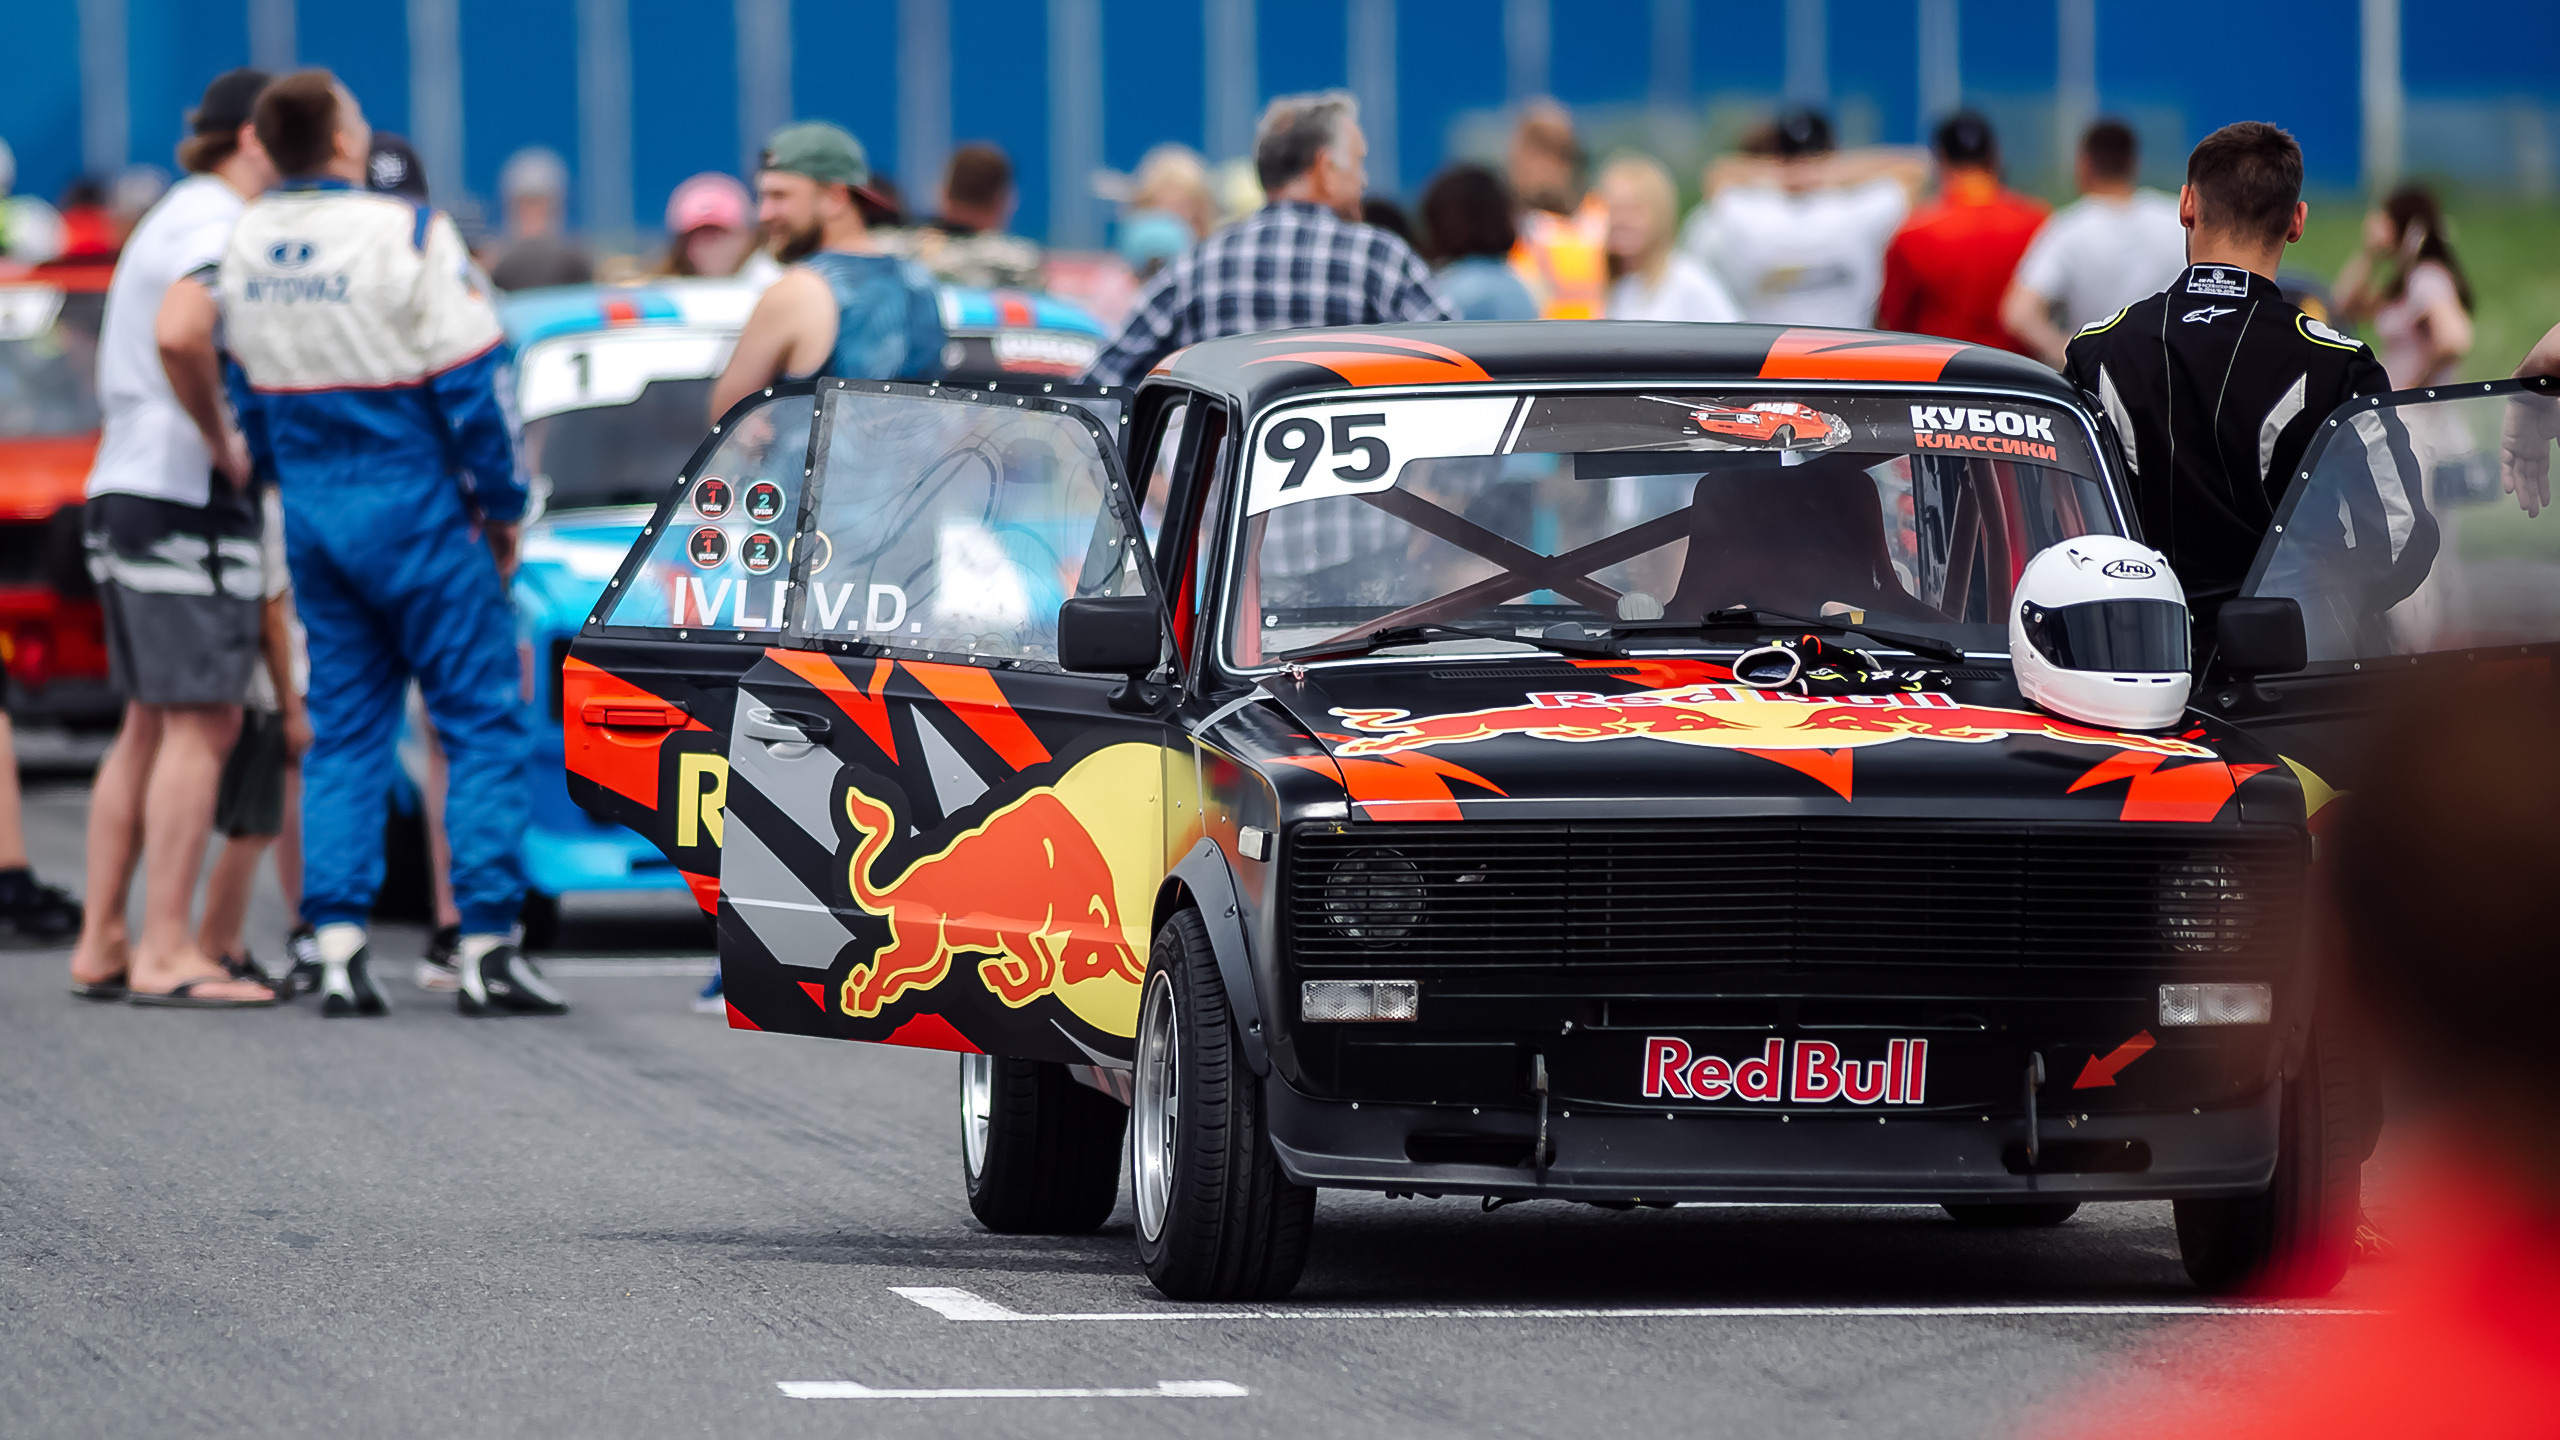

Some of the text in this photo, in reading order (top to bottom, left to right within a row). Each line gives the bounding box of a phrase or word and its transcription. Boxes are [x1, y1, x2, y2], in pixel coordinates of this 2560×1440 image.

[568, 350, 591, 391] 1
[1910, 404, 2056, 443] КУБОК
[1264, 413, 1391, 491] 95
[1914, 432, 2058, 462] КЛАССИКИ
[708, 489, 716, 504] 1
[758, 494, 770, 508] 2
[703, 538, 712, 553] 1
[754, 544, 766, 559] 2
[2107, 561, 2149, 574] Arai
[1525, 685, 1744, 709] Red
[1642, 1036, 1928, 1104] Red Bull
